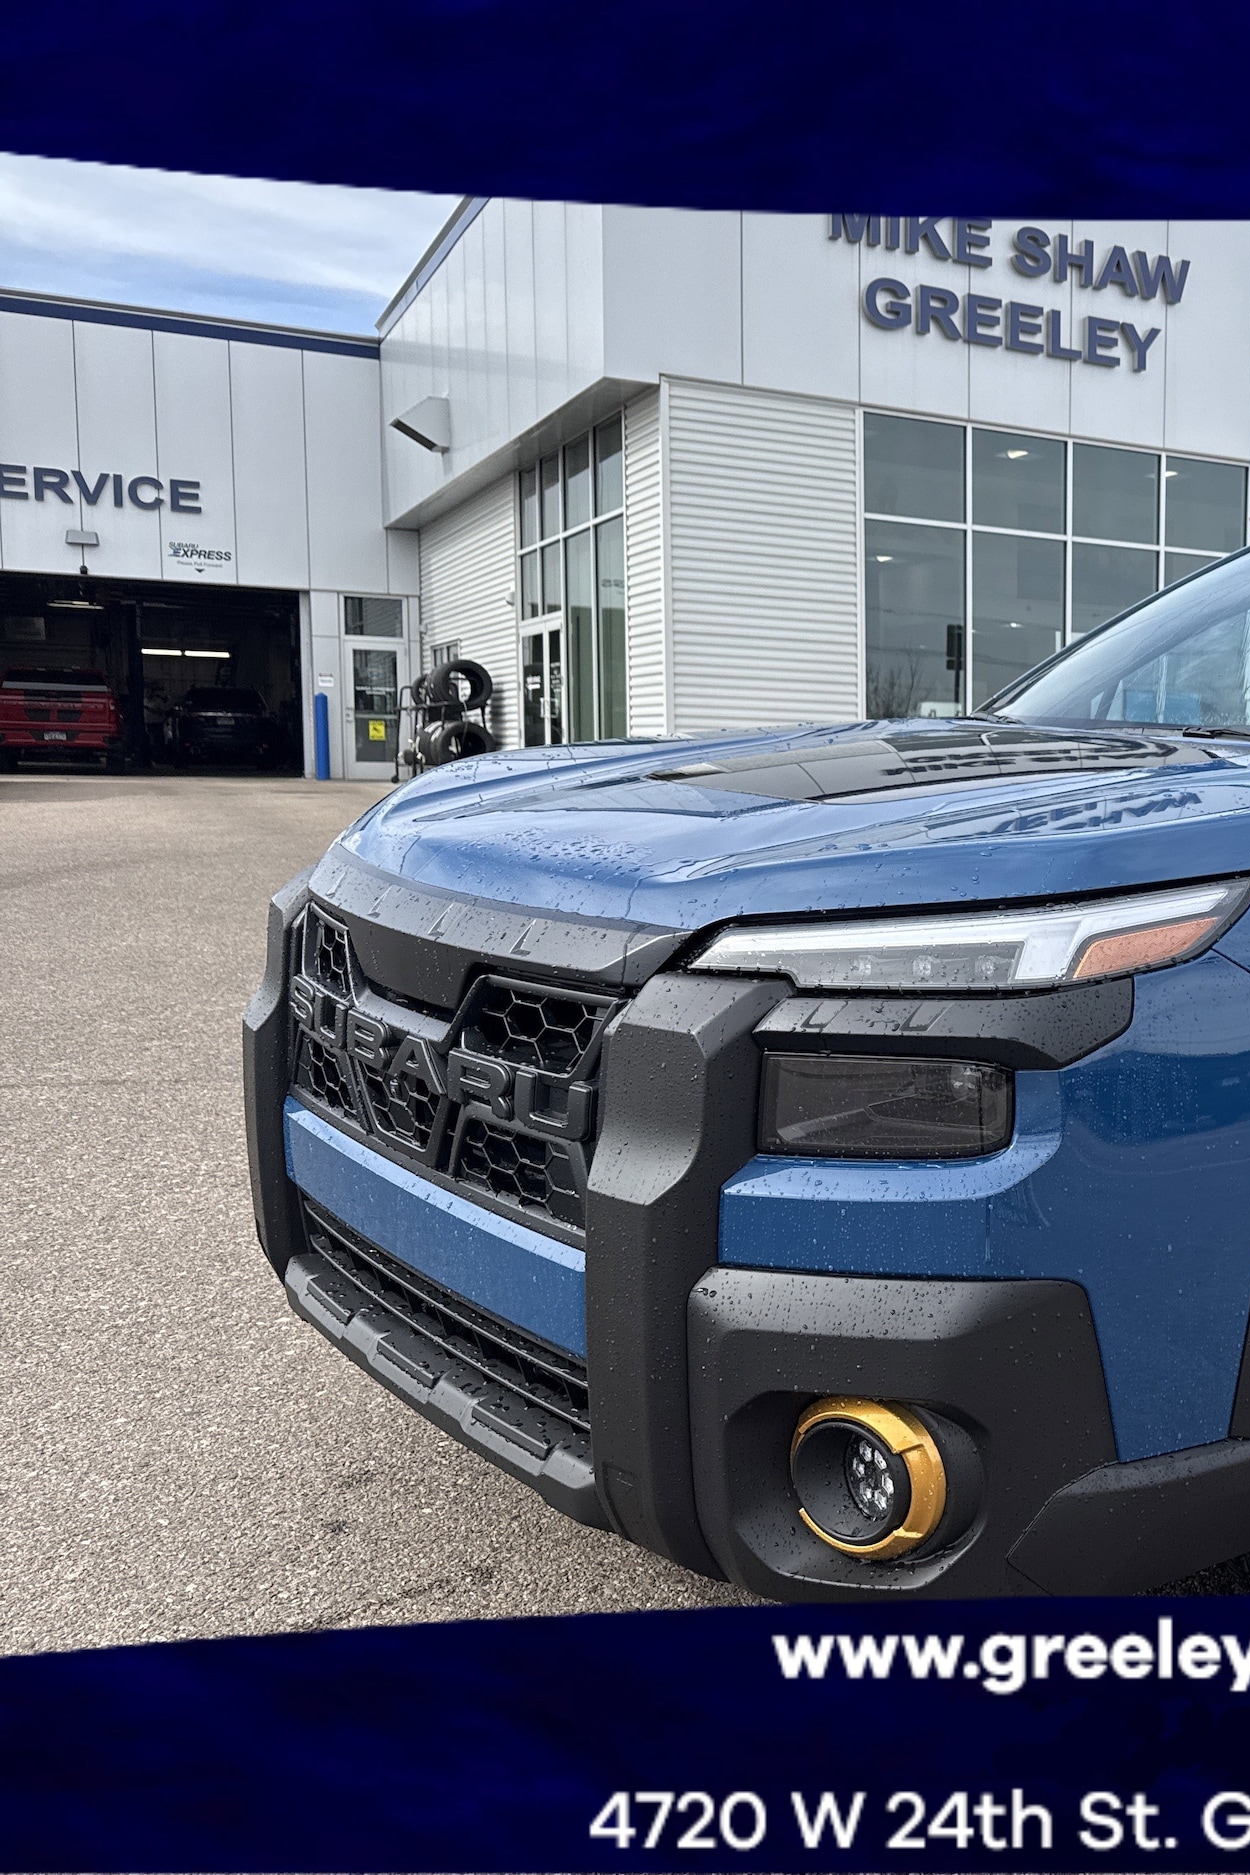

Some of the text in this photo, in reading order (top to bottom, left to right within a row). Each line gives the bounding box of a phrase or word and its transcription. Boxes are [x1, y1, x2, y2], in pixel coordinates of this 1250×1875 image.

[828, 213, 1191, 305] MIKE SHAW
[863, 277, 1161, 372] GREELEY
[168, 541, 199, 549] SUBARU
[168, 547, 232, 562] EXPRESS
[292, 974, 598, 1142] SUBARU
